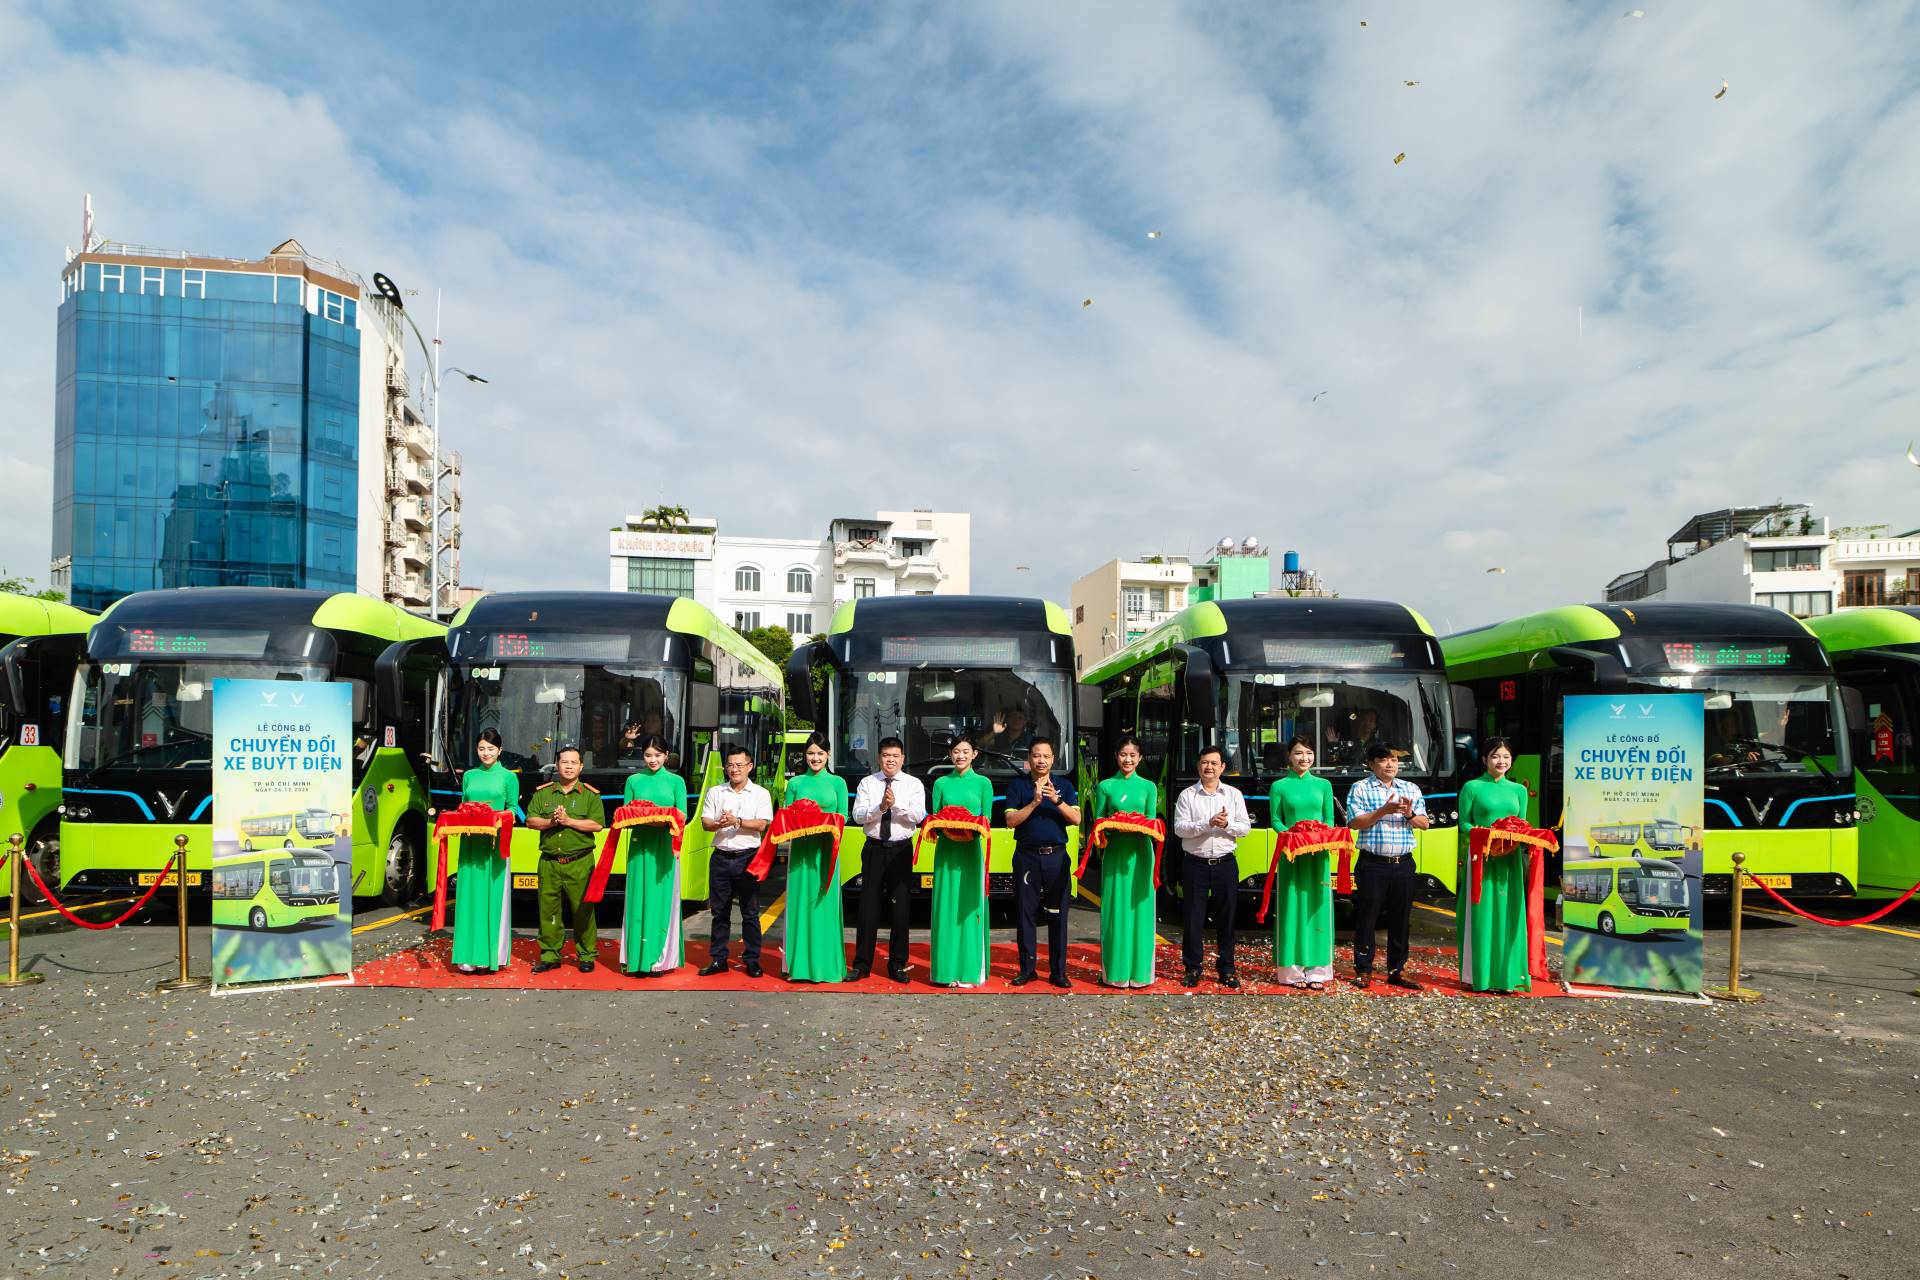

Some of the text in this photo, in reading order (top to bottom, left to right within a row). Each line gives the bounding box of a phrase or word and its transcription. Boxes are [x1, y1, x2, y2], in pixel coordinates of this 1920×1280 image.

[1500, 680, 1516, 700] 150
[24, 726, 36, 744] 33
[271, 722, 296, 732] CÔNG
[230, 734, 336, 753] CHUYỂN ĐỔI
[1619, 733, 1645, 743] CÔNG
[223, 753, 342, 773] XE BUÝT ĐIỆN
[1580, 745, 1686, 764] CHUYỂN ĐỔI
[1574, 764, 1693, 784] XE BUÝT ĐIỆN
